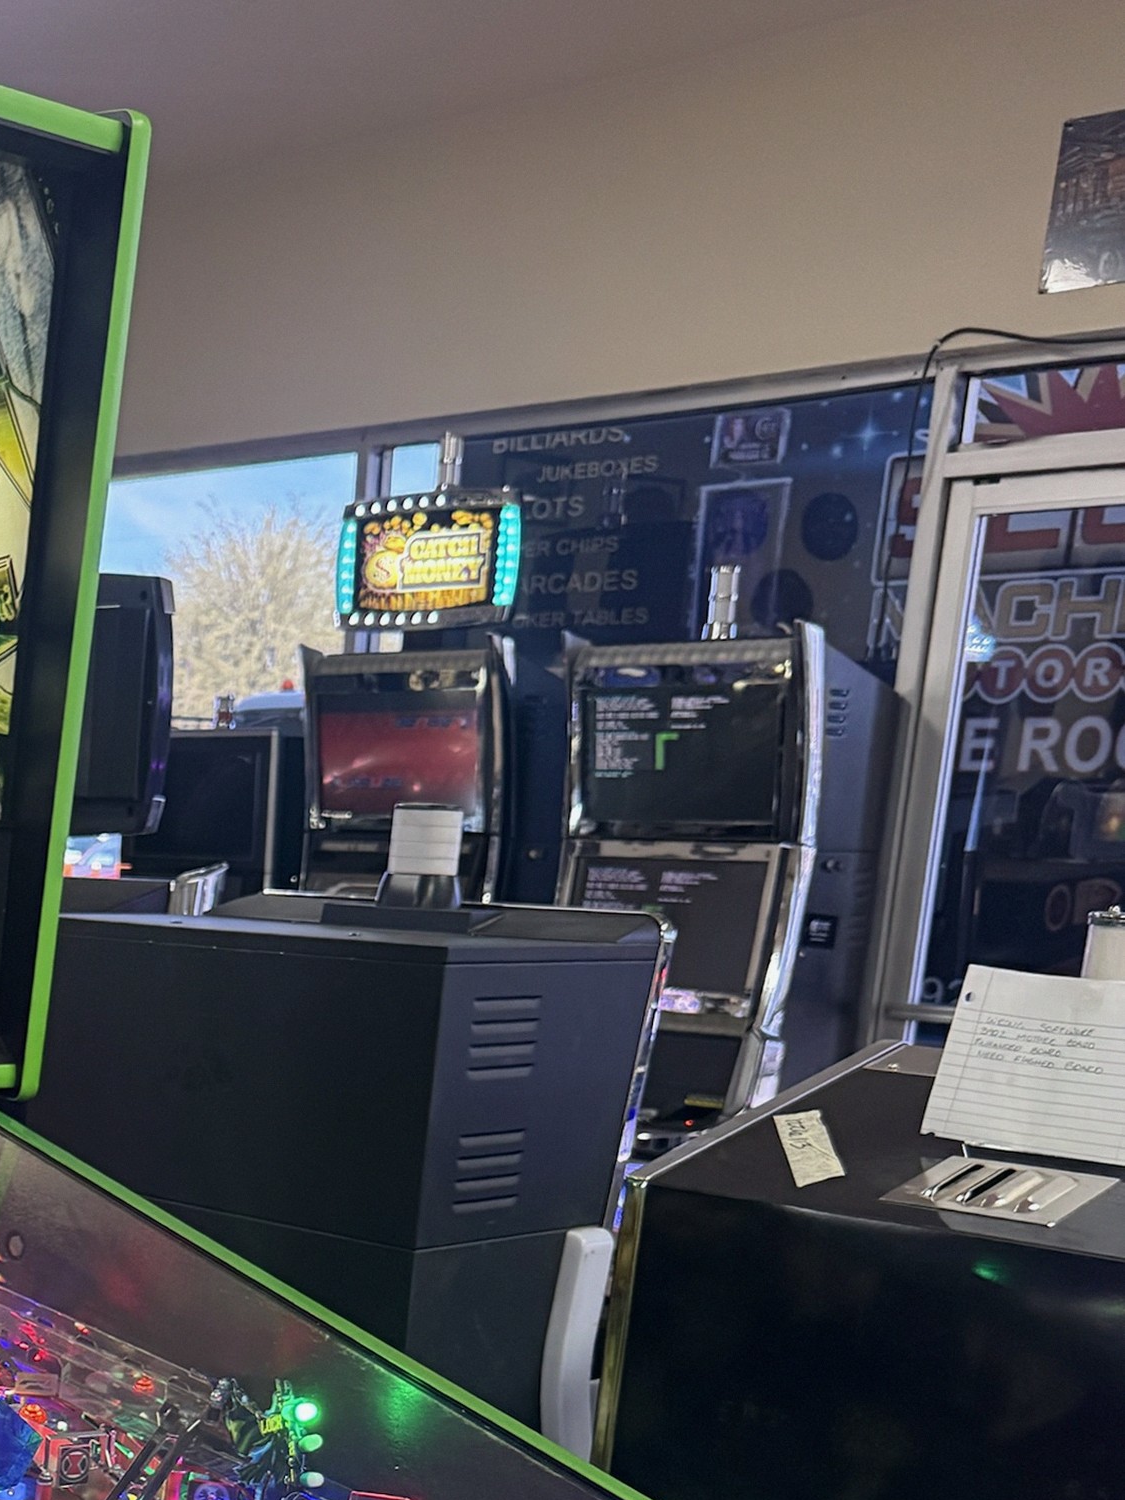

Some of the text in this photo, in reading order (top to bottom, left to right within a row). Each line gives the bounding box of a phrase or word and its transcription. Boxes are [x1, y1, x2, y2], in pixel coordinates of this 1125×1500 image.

[492, 426, 625, 454] BILLIARDS
[537, 456, 658, 483] JUKEBOXES
[409, 535, 479, 561] CATCH
[403, 556, 484, 585] MONEY
